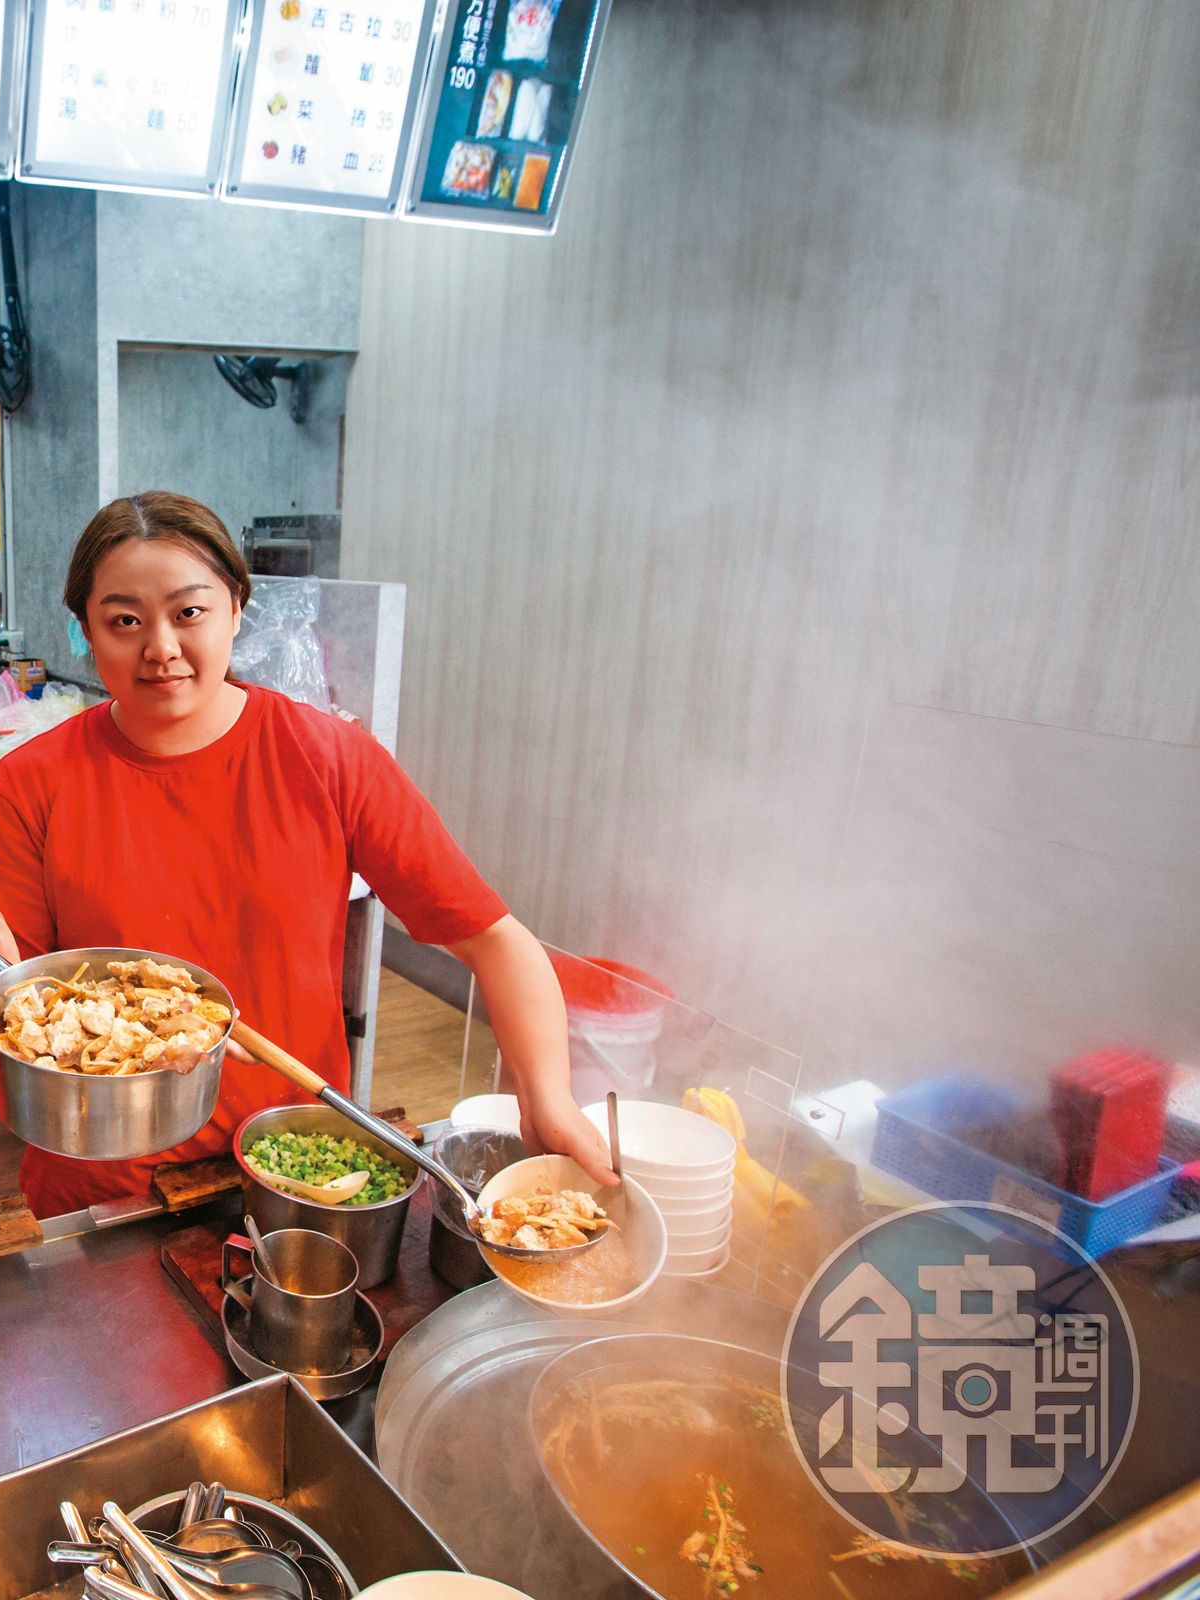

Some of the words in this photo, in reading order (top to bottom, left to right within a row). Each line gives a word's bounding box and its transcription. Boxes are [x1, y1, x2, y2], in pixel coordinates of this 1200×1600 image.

[392, 20, 413, 42] 30
[384, 66, 404, 88] 30
[450, 66, 476, 89] 190
[376, 110, 395, 131] 35
[290, 144, 360, 171] 豬血
[368, 153, 387, 174] 25
